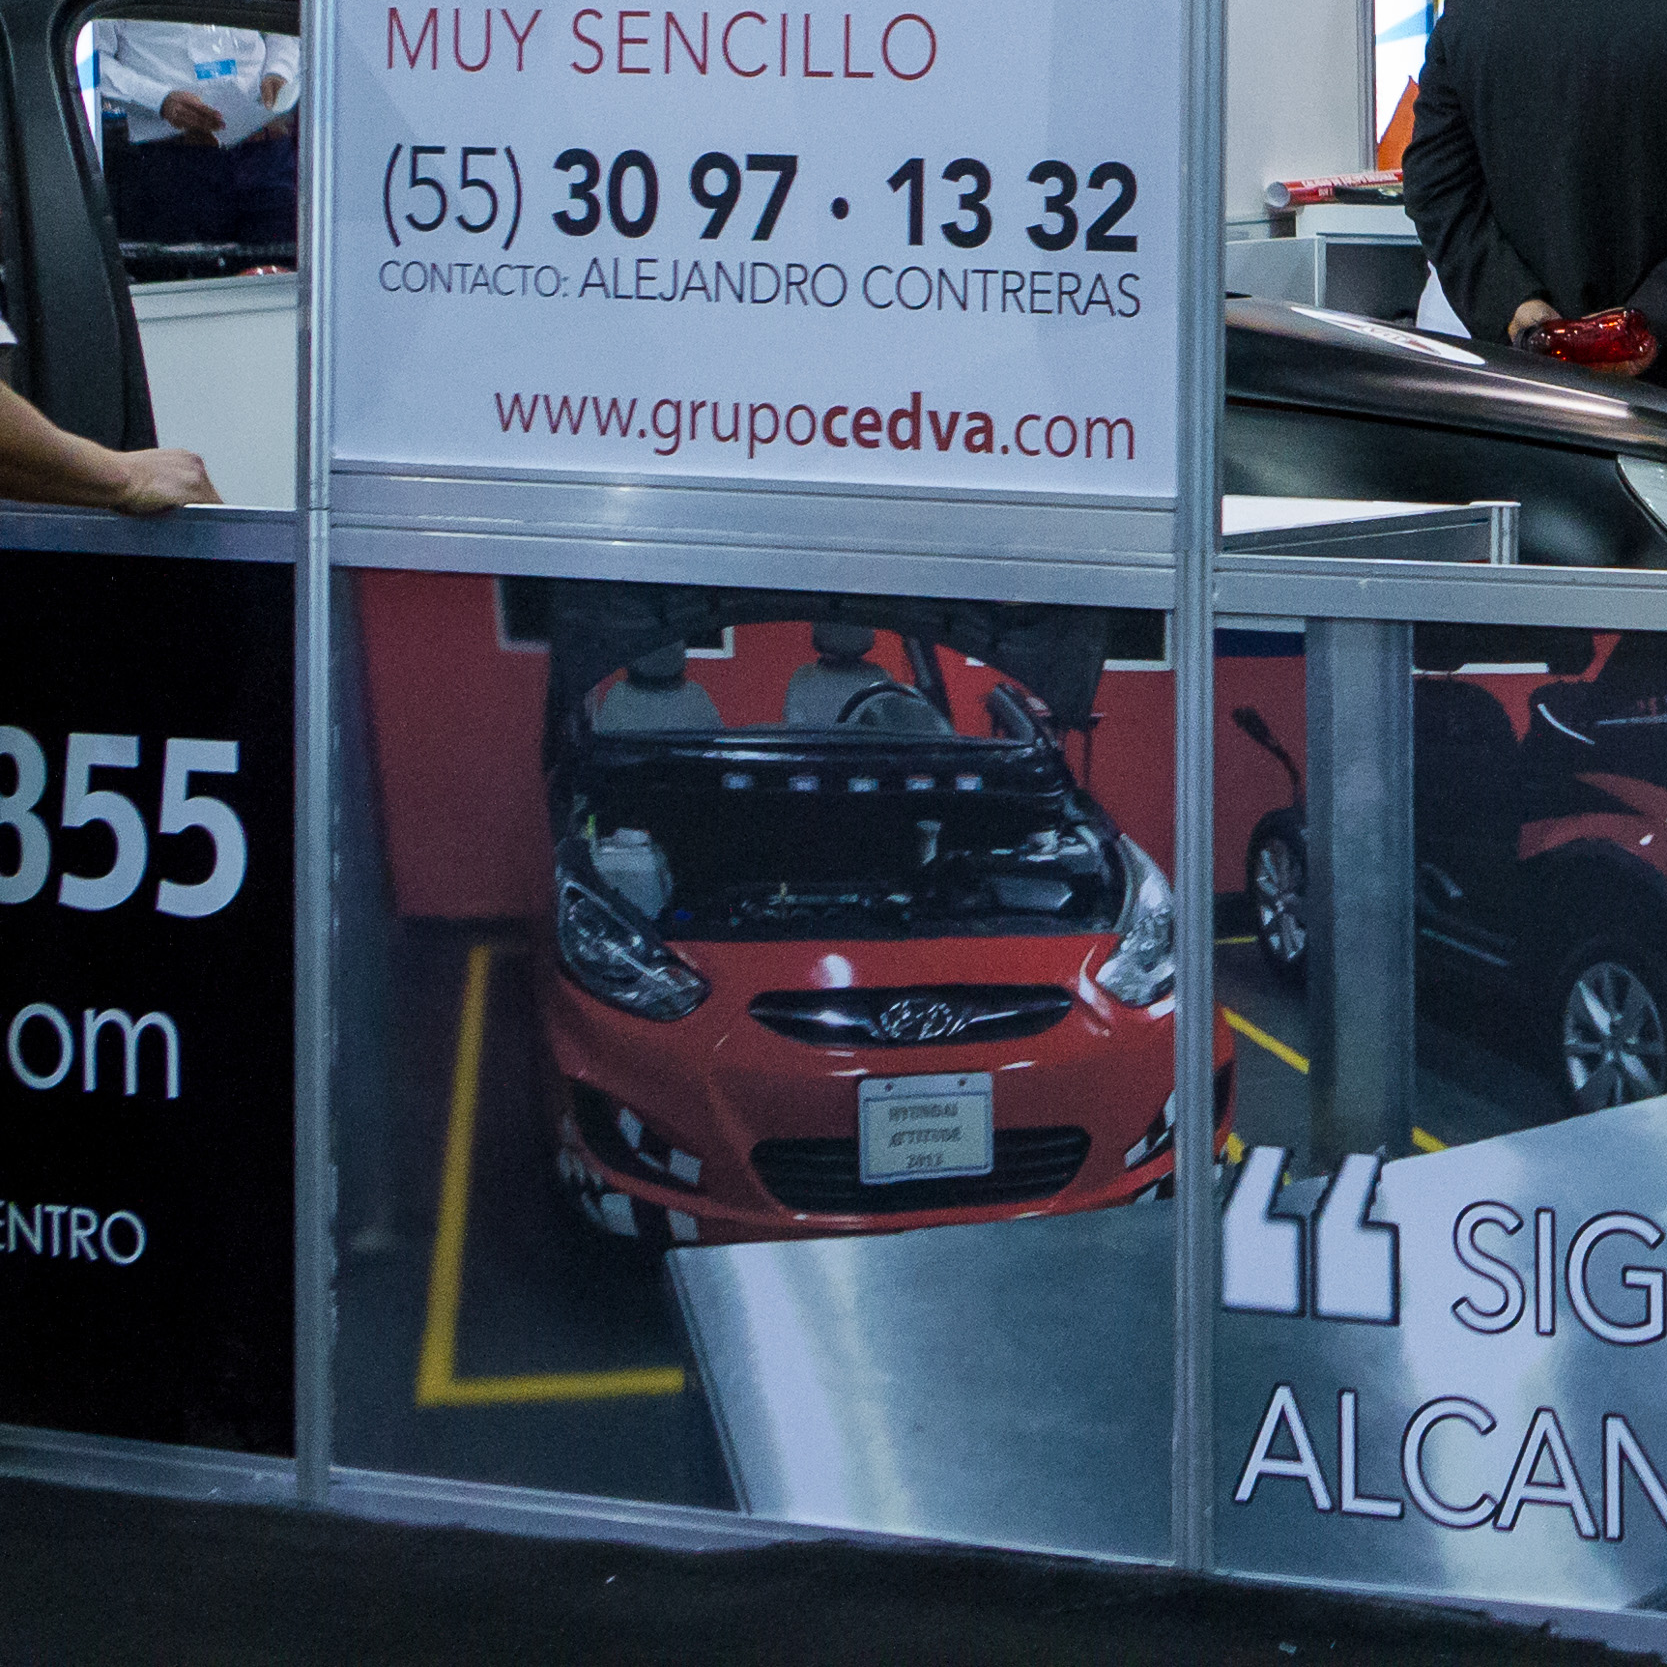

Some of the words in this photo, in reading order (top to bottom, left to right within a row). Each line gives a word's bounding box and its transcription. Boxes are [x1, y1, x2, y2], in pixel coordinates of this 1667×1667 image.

[386, 8, 544, 72] MUY
[570, 10, 939, 80] SENCILLO
[383, 143, 523, 248] (55)
[553, 148, 659, 239] 30
[689, 152, 798, 242] 97
[886, 157, 993, 248] 13
[1026, 160, 1140, 253] 32
[379, 259, 569, 299] CONTACTO:
[579, 257, 849, 309] ALEJANDRO
[862, 266, 1141, 319] CONTRERAS
[494, 392, 1136, 460] www.grupocedva.com
